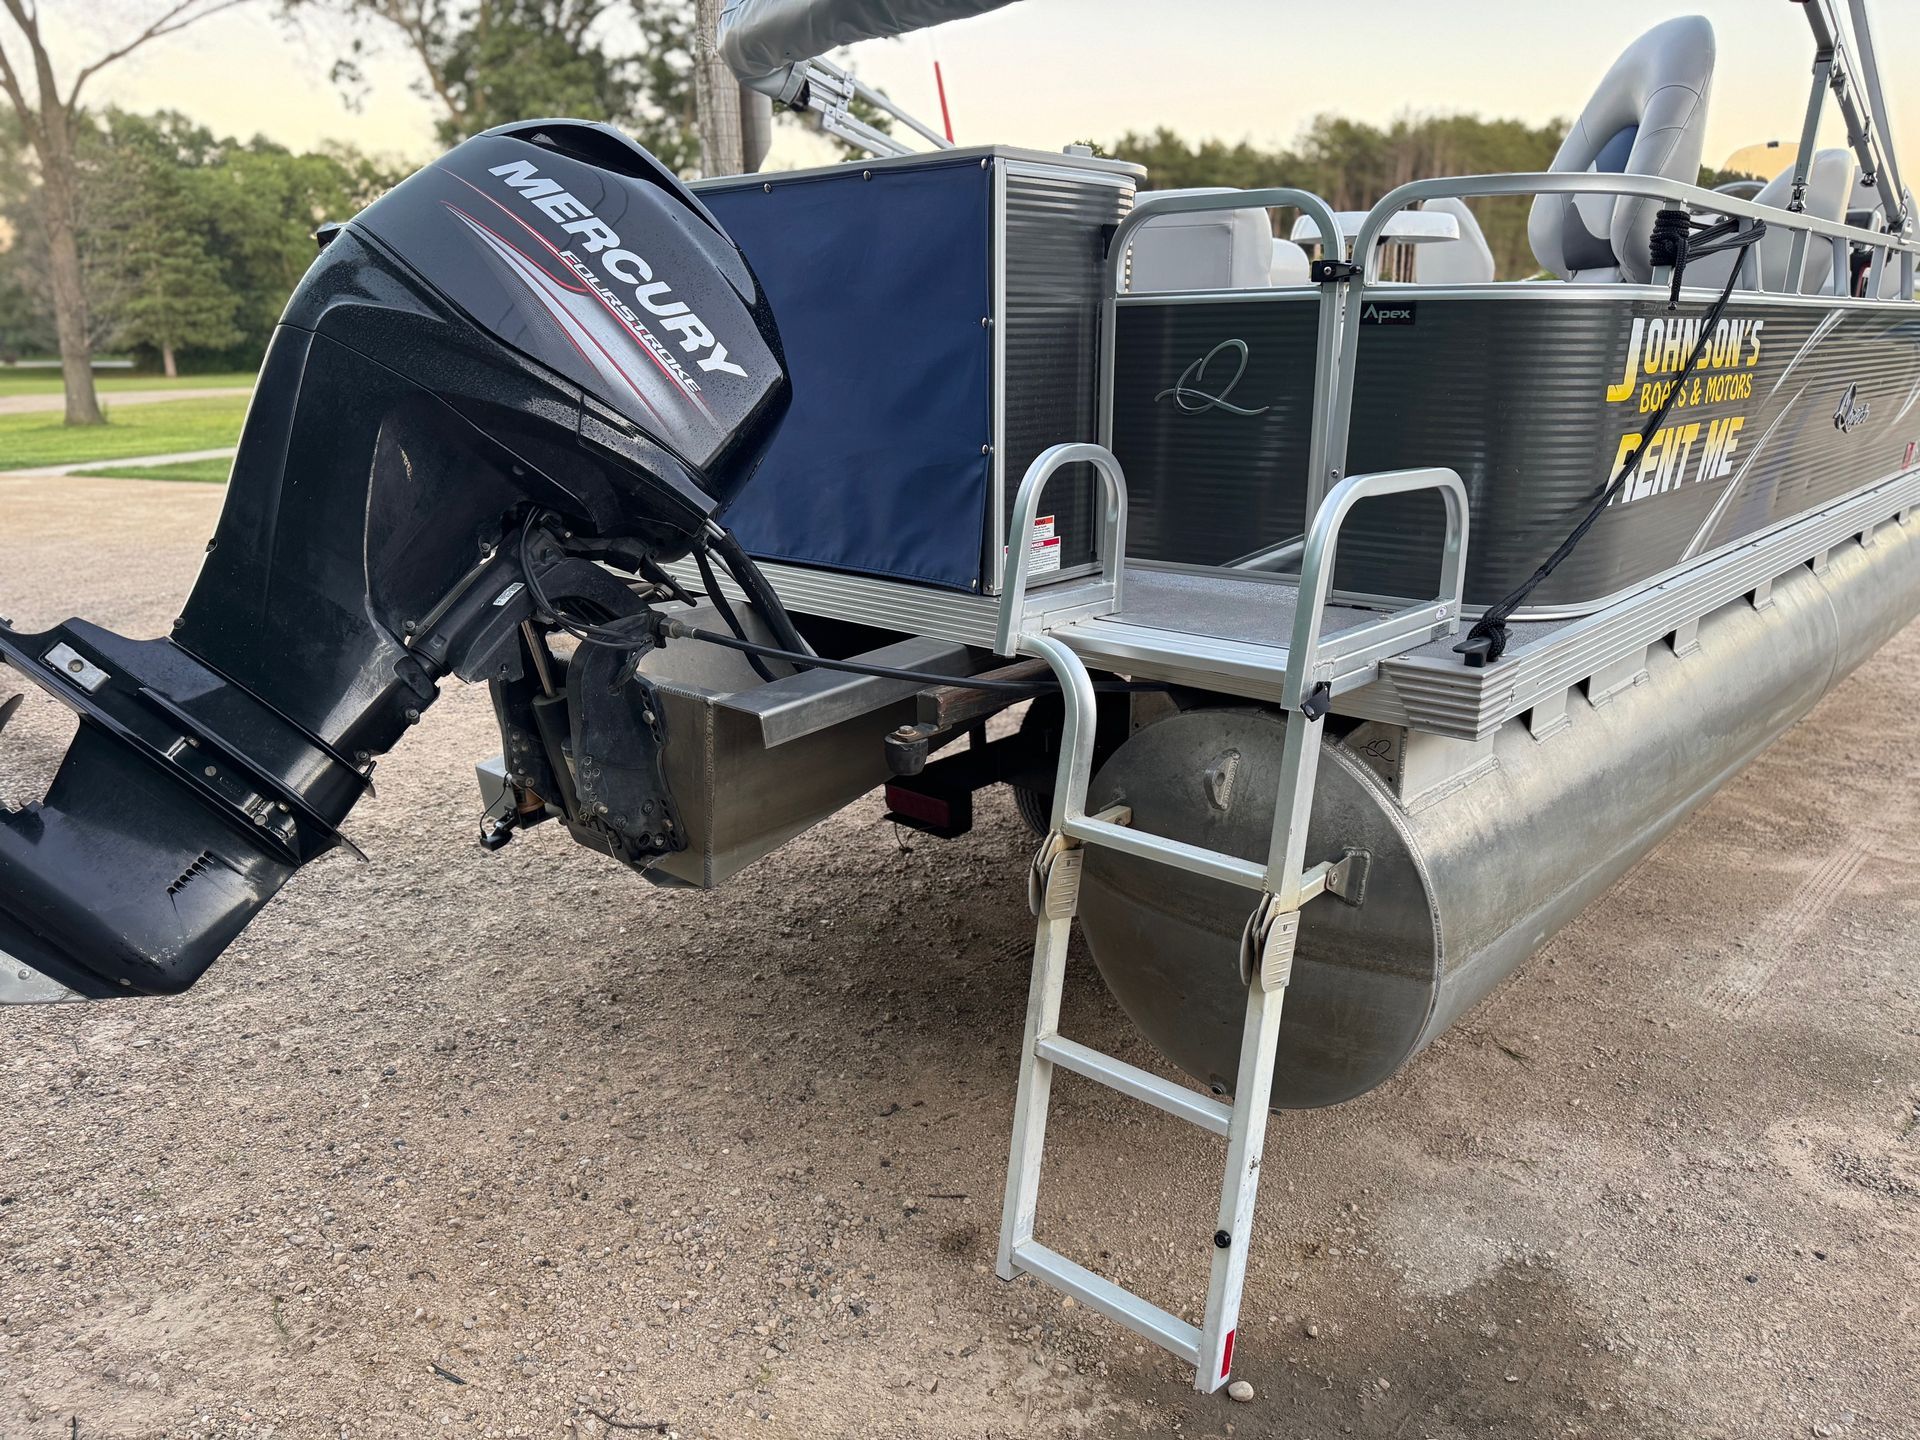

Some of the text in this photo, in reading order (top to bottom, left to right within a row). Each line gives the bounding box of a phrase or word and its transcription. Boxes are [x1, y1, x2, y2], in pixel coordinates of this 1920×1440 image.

[488, 159, 749, 378] MERCURY
[1362, 303, 1411, 324] Apex
[559, 250, 702, 393] FOURSTROKE
[1689, 377, 1702, 406] &
[1704, 372, 1753, 404] MOTORS
[1604, 416, 1745, 507] RENT ME
